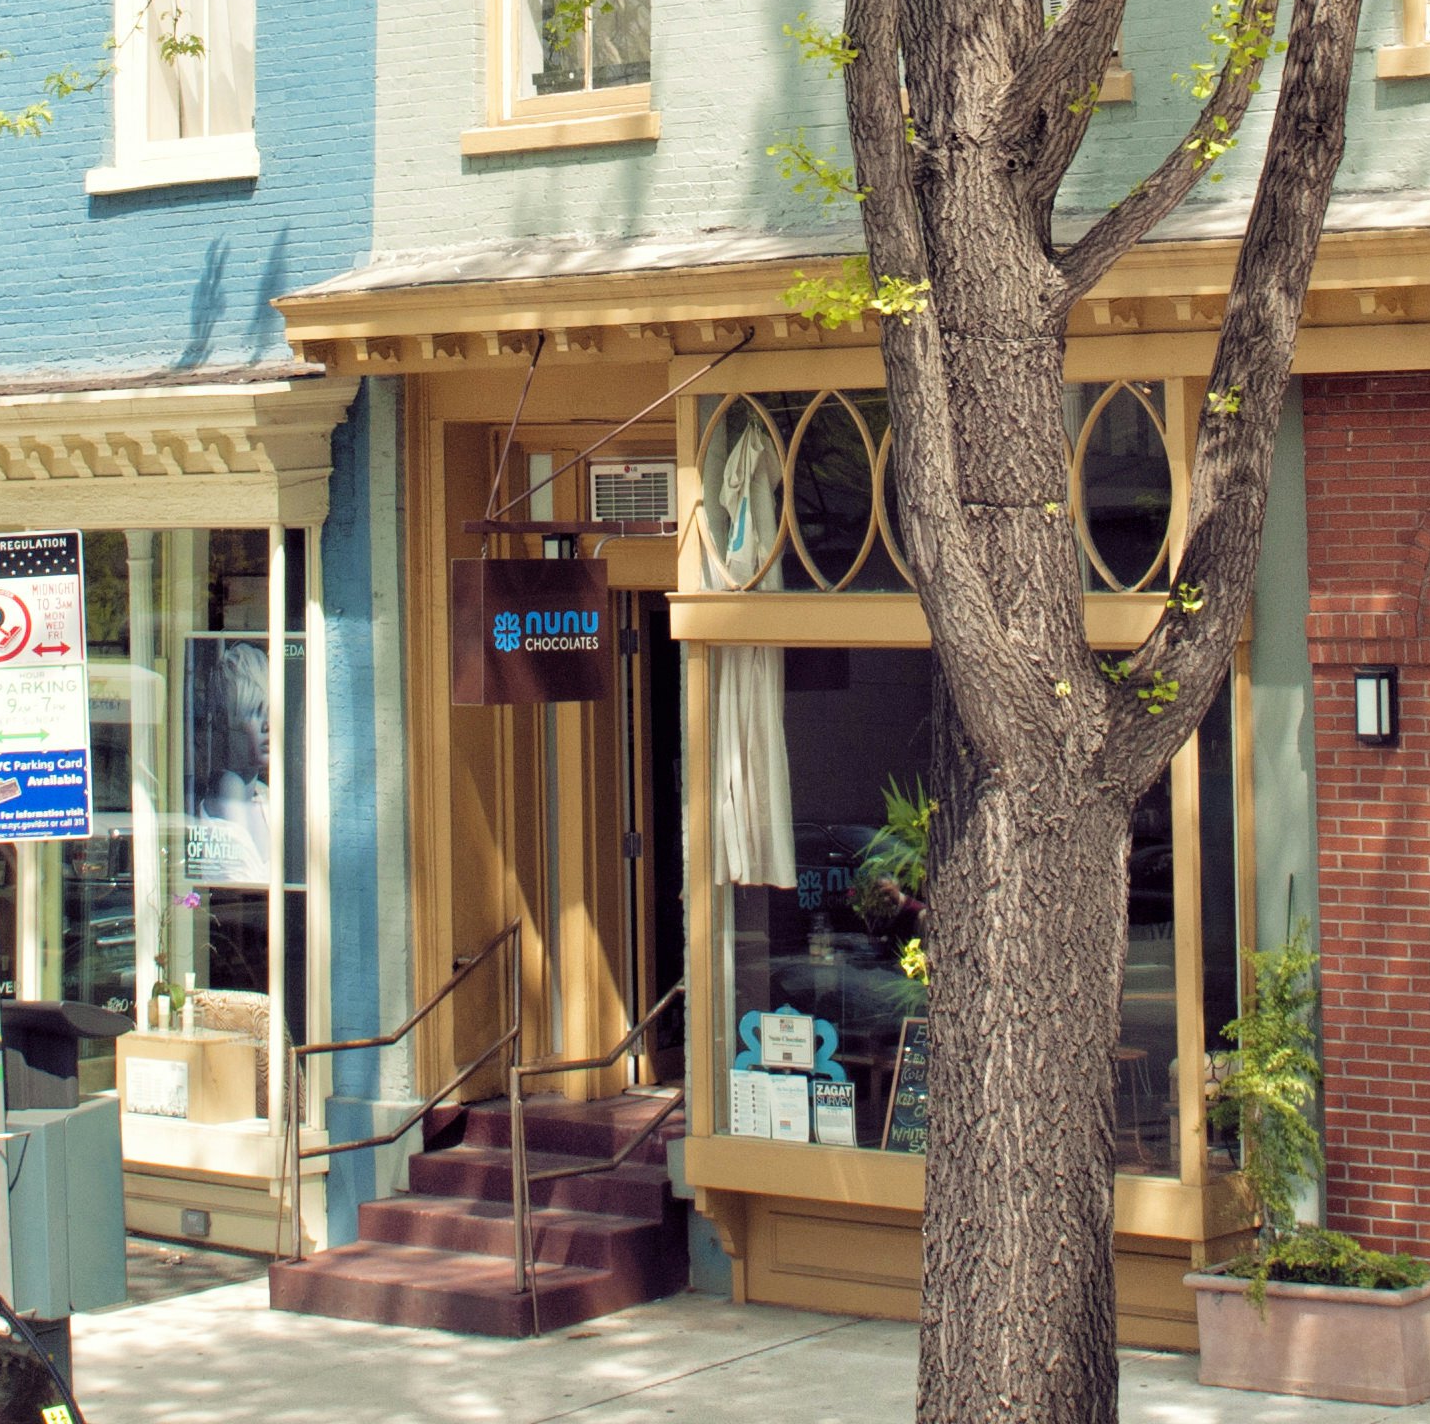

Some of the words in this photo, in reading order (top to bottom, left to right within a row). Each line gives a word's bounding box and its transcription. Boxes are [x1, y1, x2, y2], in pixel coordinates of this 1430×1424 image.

[0, 537, 67, 551] REGULATION
[32, 582, 75, 596] MIDNIGHT
[37, 598, 50, 611] TO
[44, 612, 65, 620] MON
[525, 610, 599, 635] nunu
[45, 621, 65, 630] WED
[47, 630, 63, 640] FRI
[525, 635, 599, 652] CHOCOLATES
[13, 760, 55, 772] Parking
[57, 758, 83, 769] Card
[27, 774, 83, 787] Available
[0, 811, 15, 819] For
[15, 808, 64, 819] information
[65, 807, 84, 817] visit
[187, 824, 208, 842] THE
[210, 825, 233, 842] ART
[187, 841, 203, 858] OF
[816, 1084, 852, 1097] ZAGAT
[816, 1097, 852, 1107] SURVEY
